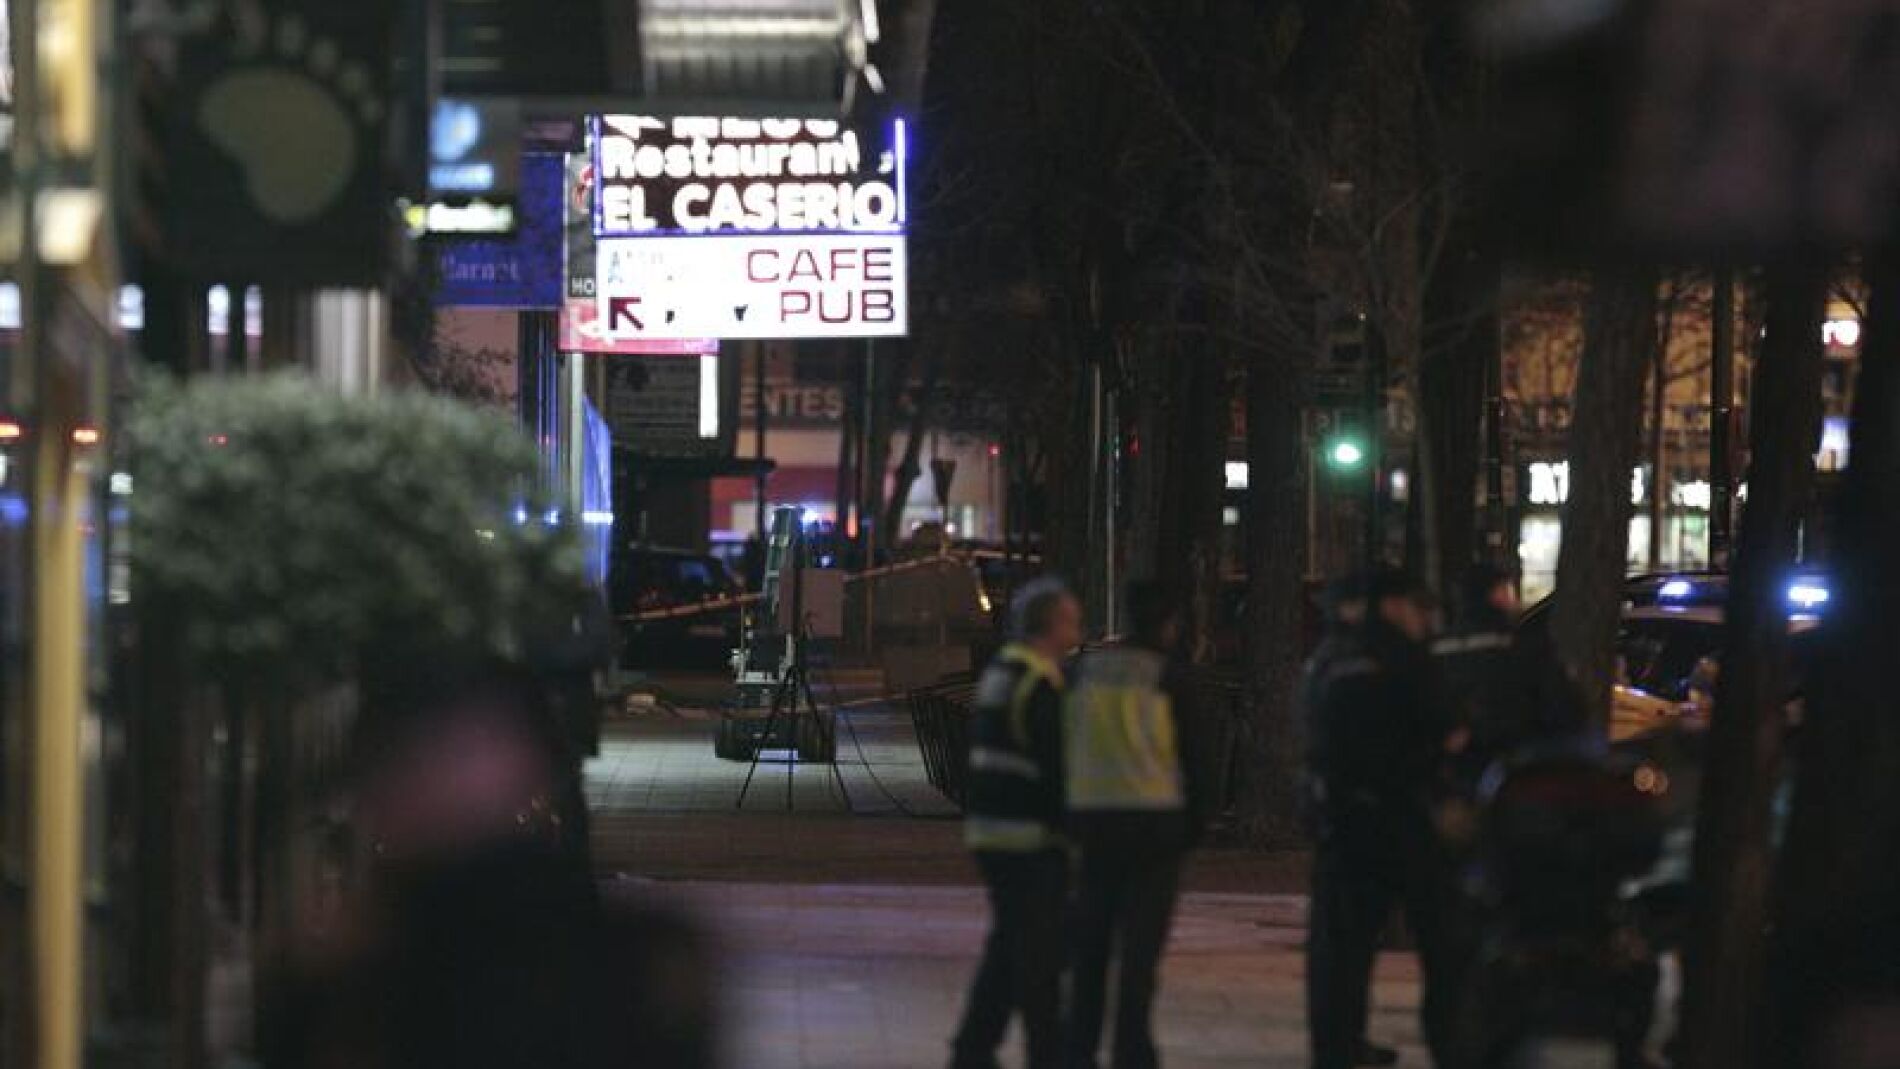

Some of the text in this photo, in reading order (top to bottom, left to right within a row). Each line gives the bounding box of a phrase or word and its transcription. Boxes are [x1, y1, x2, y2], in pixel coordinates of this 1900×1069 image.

[601, 182, 897, 231] EL CASERIO
[746, 247, 894, 283] CAFE
[780, 289, 897, 323] PUB
